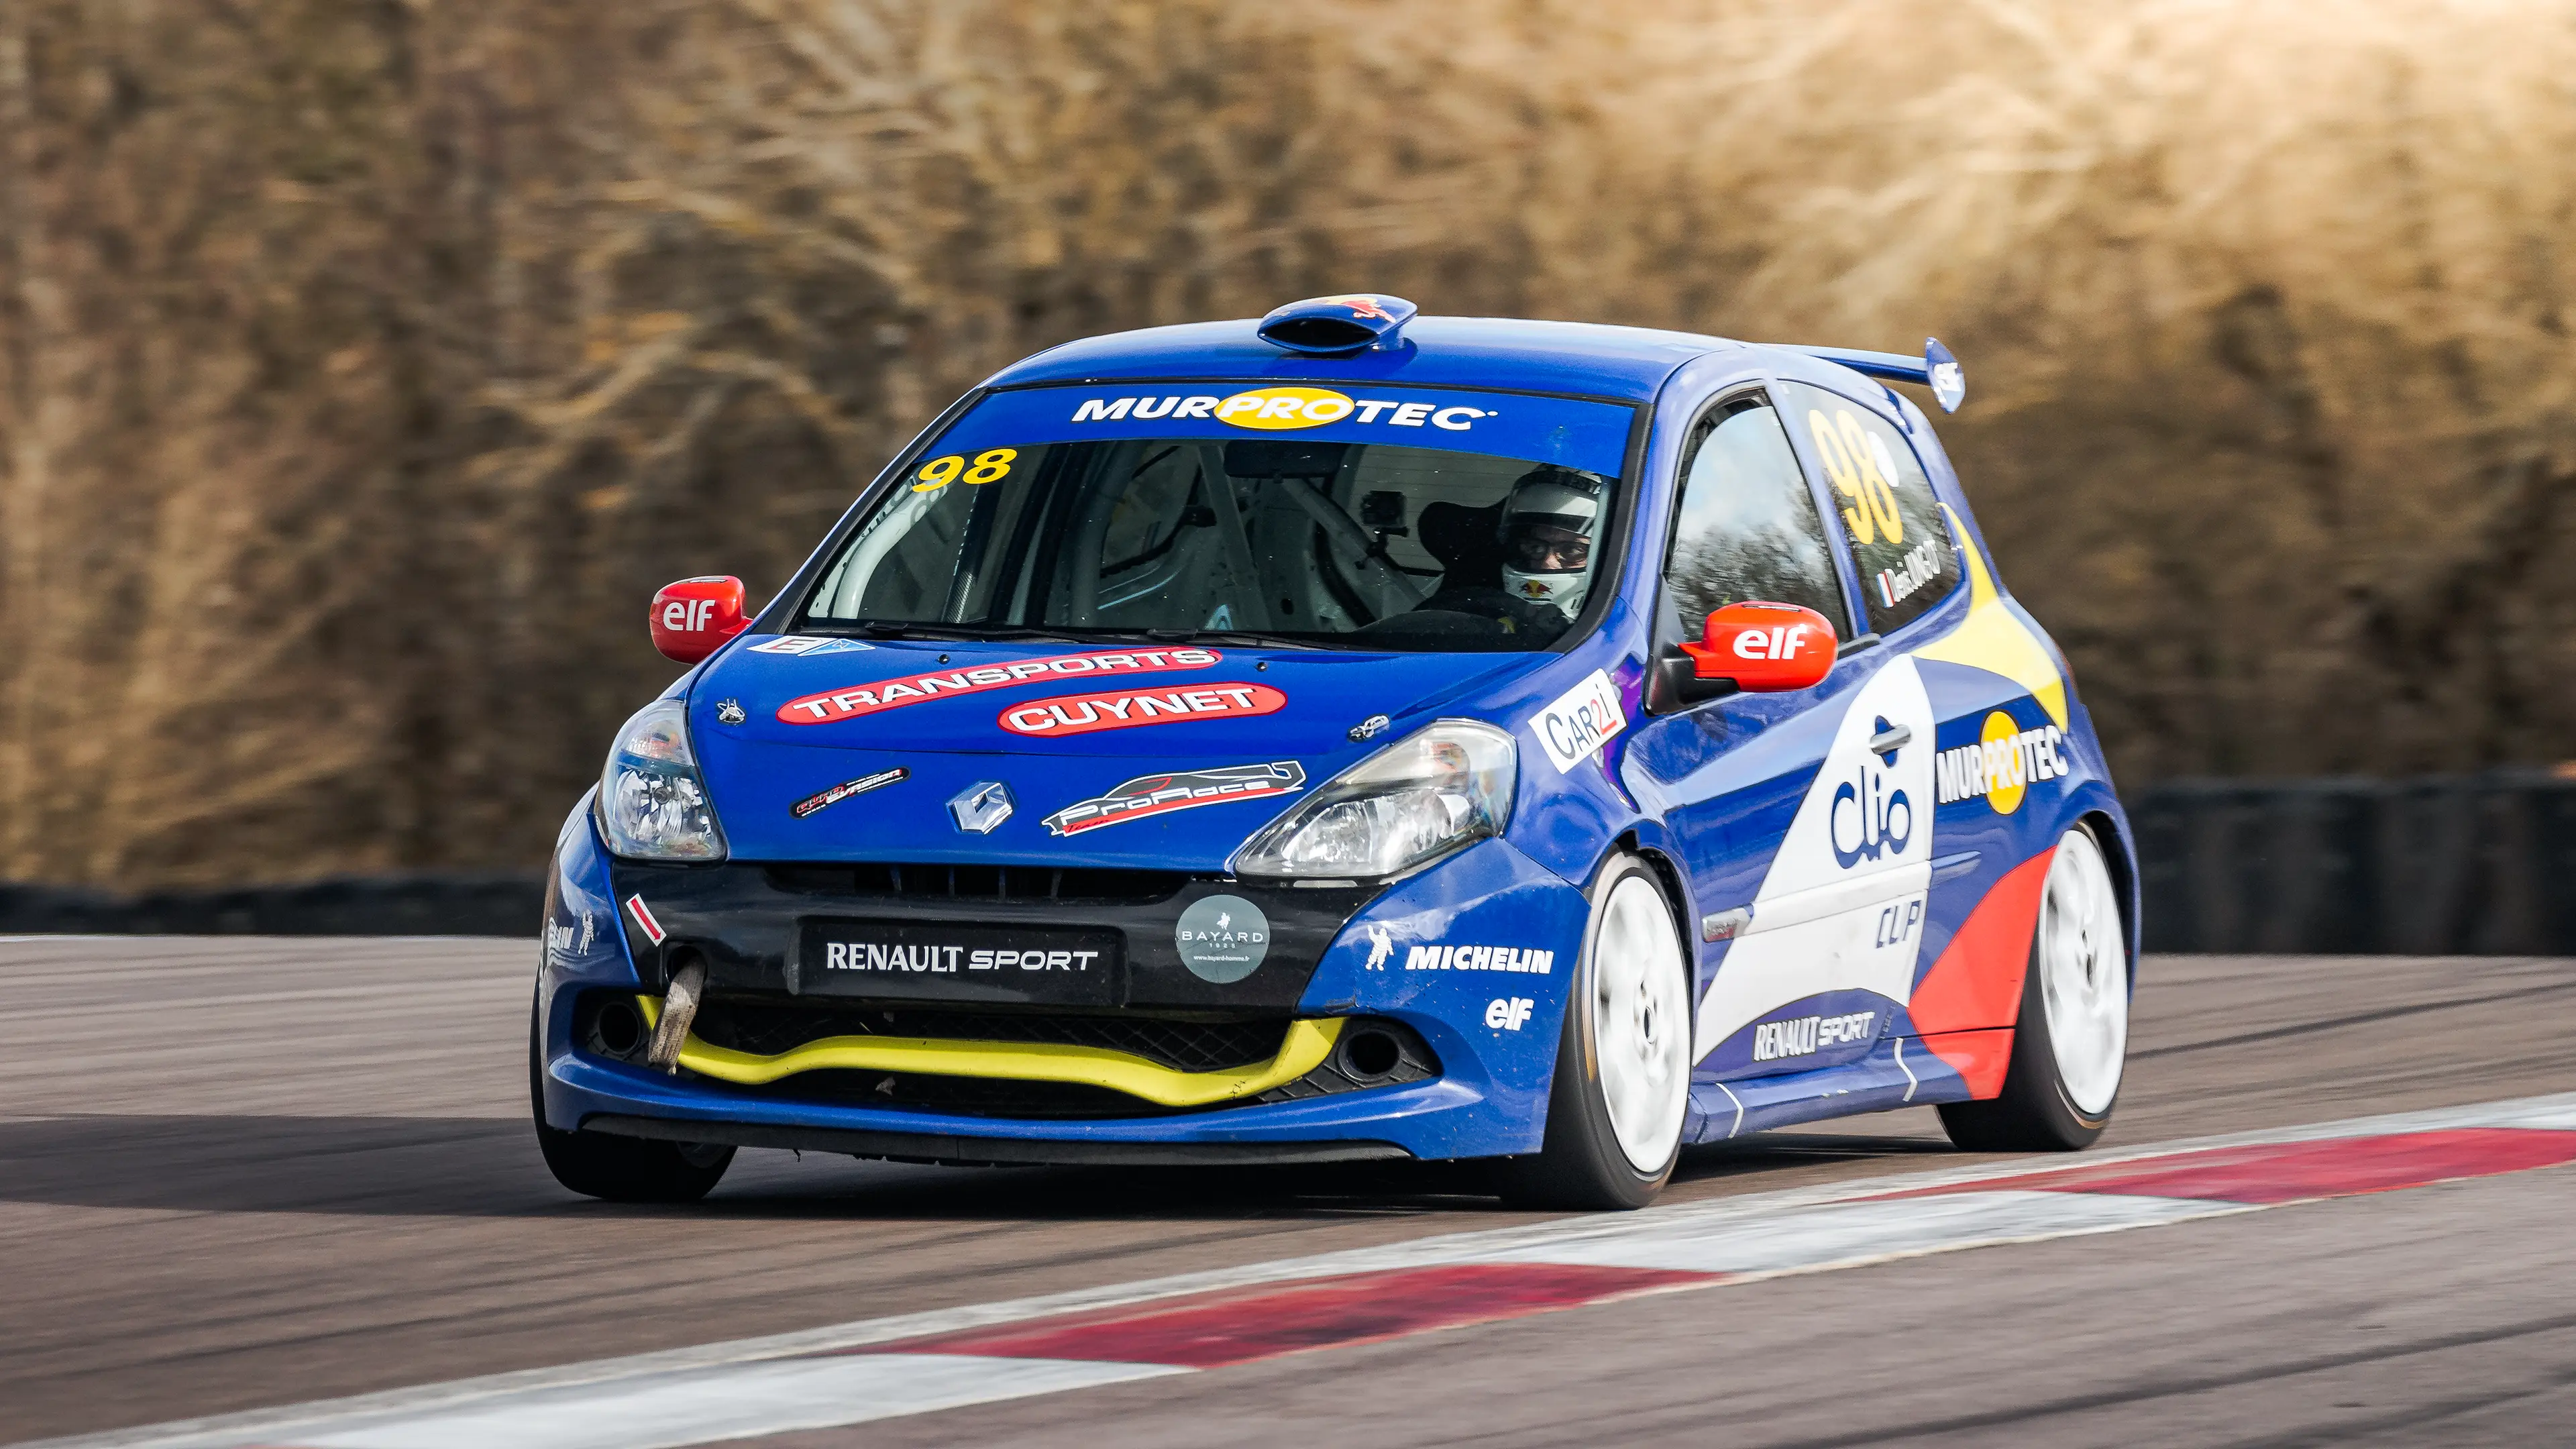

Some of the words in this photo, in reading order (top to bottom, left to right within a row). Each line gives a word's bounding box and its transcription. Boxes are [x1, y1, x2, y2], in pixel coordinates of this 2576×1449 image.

[1071, 396, 1486, 431] MURPROTEC
[912, 448, 1018, 493] 98
[1809, 409, 1903, 544] 98
[663, 600, 716, 631] elf
[1733, 623, 1808, 660] elf
[793, 649, 1216, 720] TRANSPORTS
[1008, 687, 1256, 732] CUYNET
[1936, 724, 2070, 805] MURPROTEC
[1181, 930, 1263, 943] BAYARD
[826, 942, 963, 972] RENAULT
[968, 950, 1099, 971] SPORT
[1405, 945, 1554, 974] MICHELIN
[1485, 996, 1534, 1031] elf
[1753, 1016, 1821, 1061] RENAULT
[1817, 1011, 1876, 1046] SPORT
